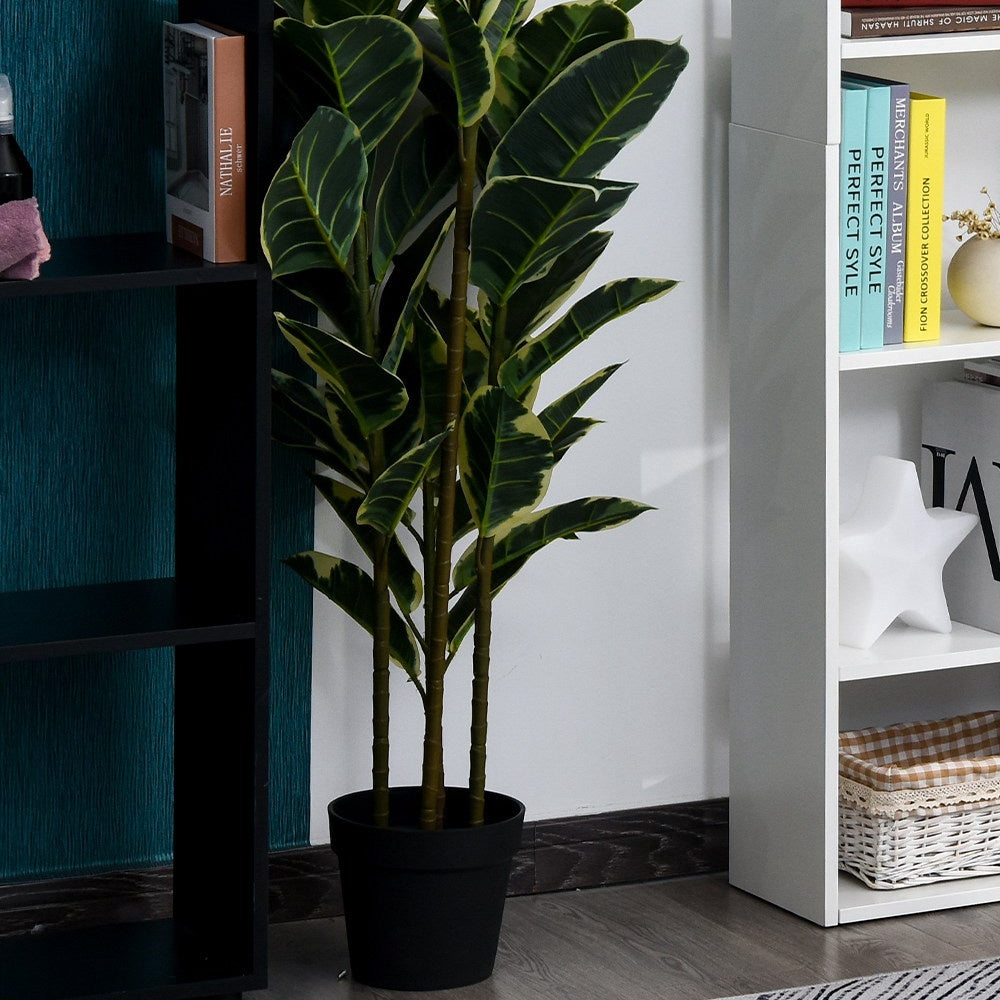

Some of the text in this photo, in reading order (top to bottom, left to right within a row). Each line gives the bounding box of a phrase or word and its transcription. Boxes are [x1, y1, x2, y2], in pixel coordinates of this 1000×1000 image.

[861, 20, 899, 31] HAASAN
[904, 18, 934, 28] SHRUTI
[939, 16, 952, 25] OF
[955, 15, 988, 25] MAGIC
[219, 126, 233, 197] NATHALIE
[890, 97, 907, 255] MERCHANTS ALBUM
[844, 149, 862, 298] PERFECT SYLE
[868, 146, 885, 295] PERFECT SYLE
[919, 177, 931, 333] FION CROSSOVER COLLECTION
